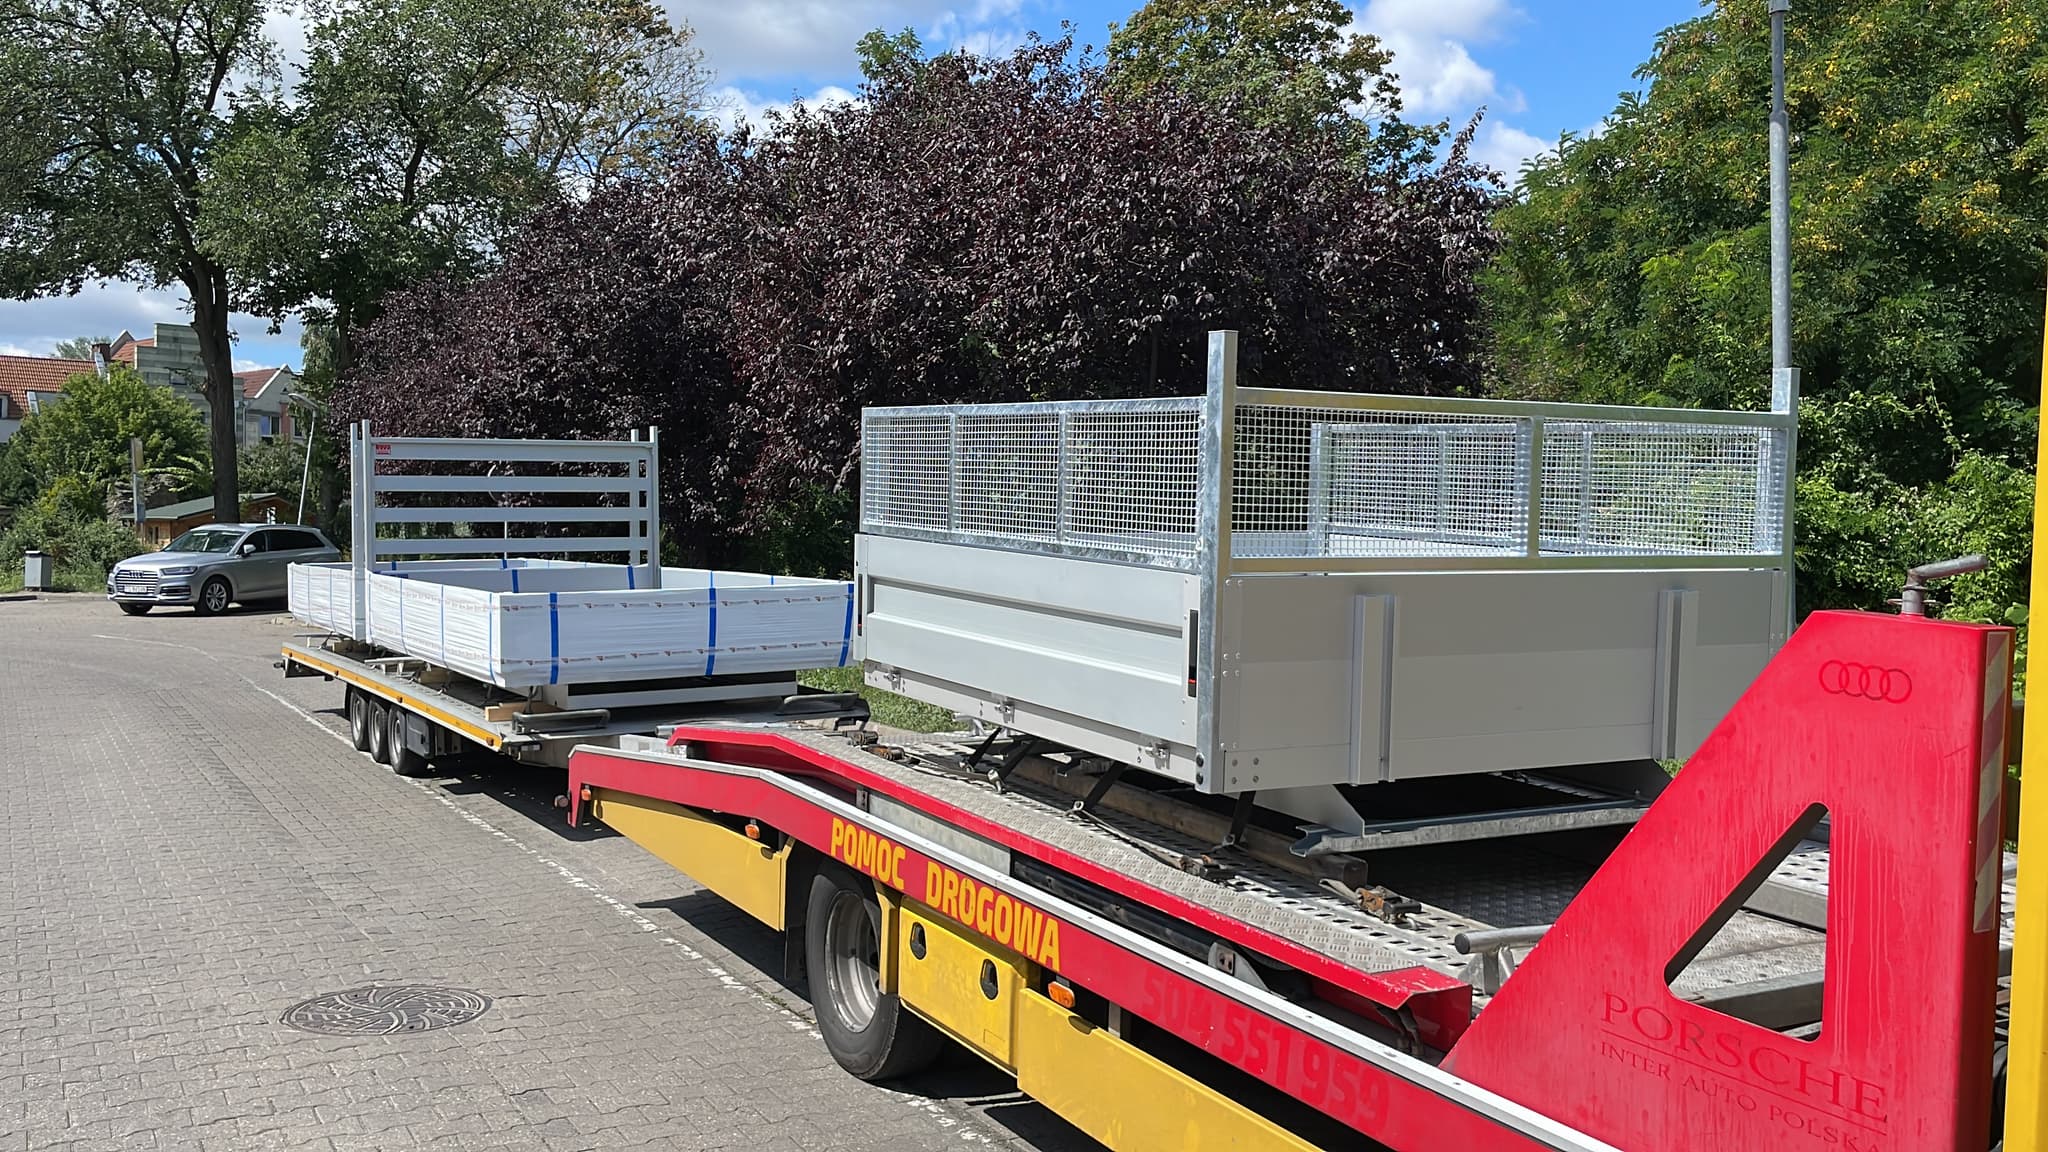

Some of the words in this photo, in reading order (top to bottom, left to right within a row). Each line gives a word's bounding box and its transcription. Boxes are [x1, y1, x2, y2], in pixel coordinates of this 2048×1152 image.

[830, 817, 907, 890] POMOC
[925, 861, 1061, 973] DROGOWA
[1222, 1006, 1291, 1089] 551
[1301, 1037, 1390, 1138] 959
[1600, 991, 1888, 1124] PORSCHE
[1601, 1041, 1671, 1081] INTER
[1683, 1074, 1757, 1112] AUTO
